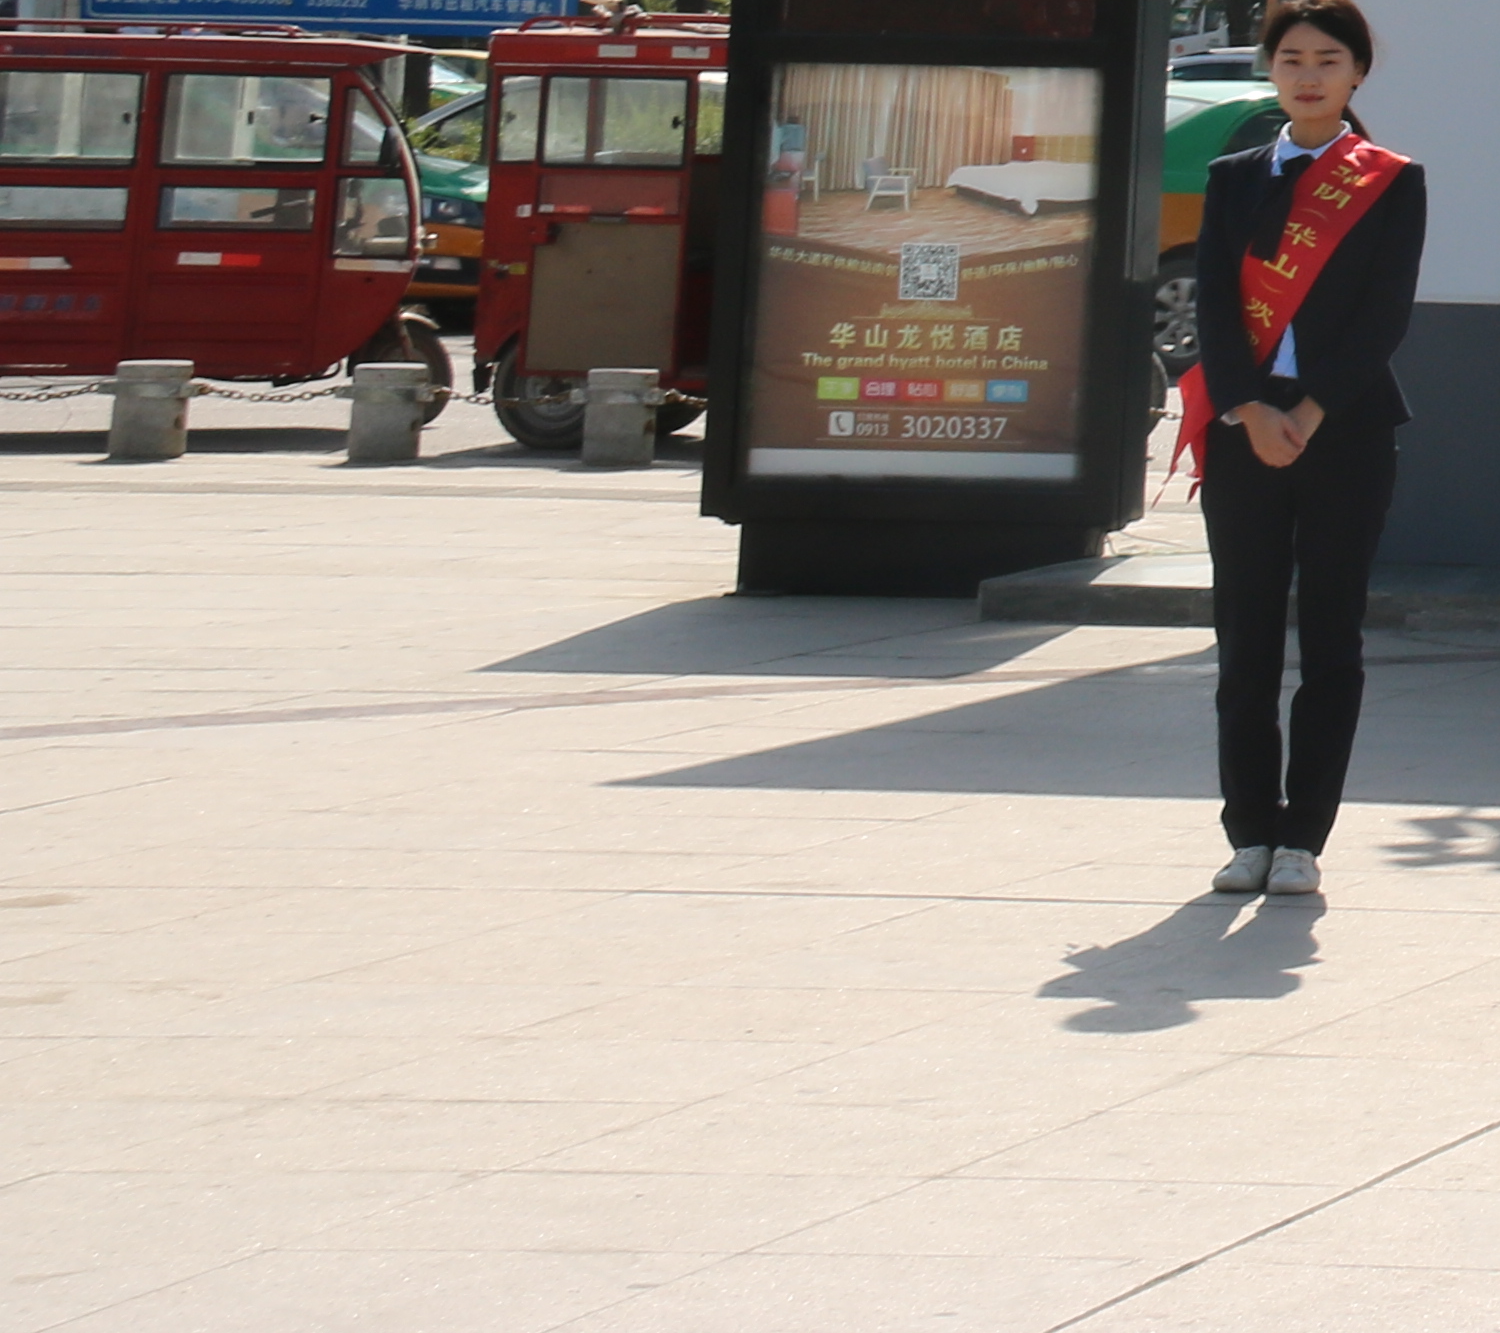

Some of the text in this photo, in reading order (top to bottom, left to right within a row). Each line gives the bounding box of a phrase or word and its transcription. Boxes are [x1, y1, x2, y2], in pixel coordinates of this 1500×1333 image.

[829, 322, 1023, 351] 华山龙悦酒店
[802, 352, 1048, 371] The grand hyatt hotel in China
[857, 415, 1008, 439] 0913 3020337
